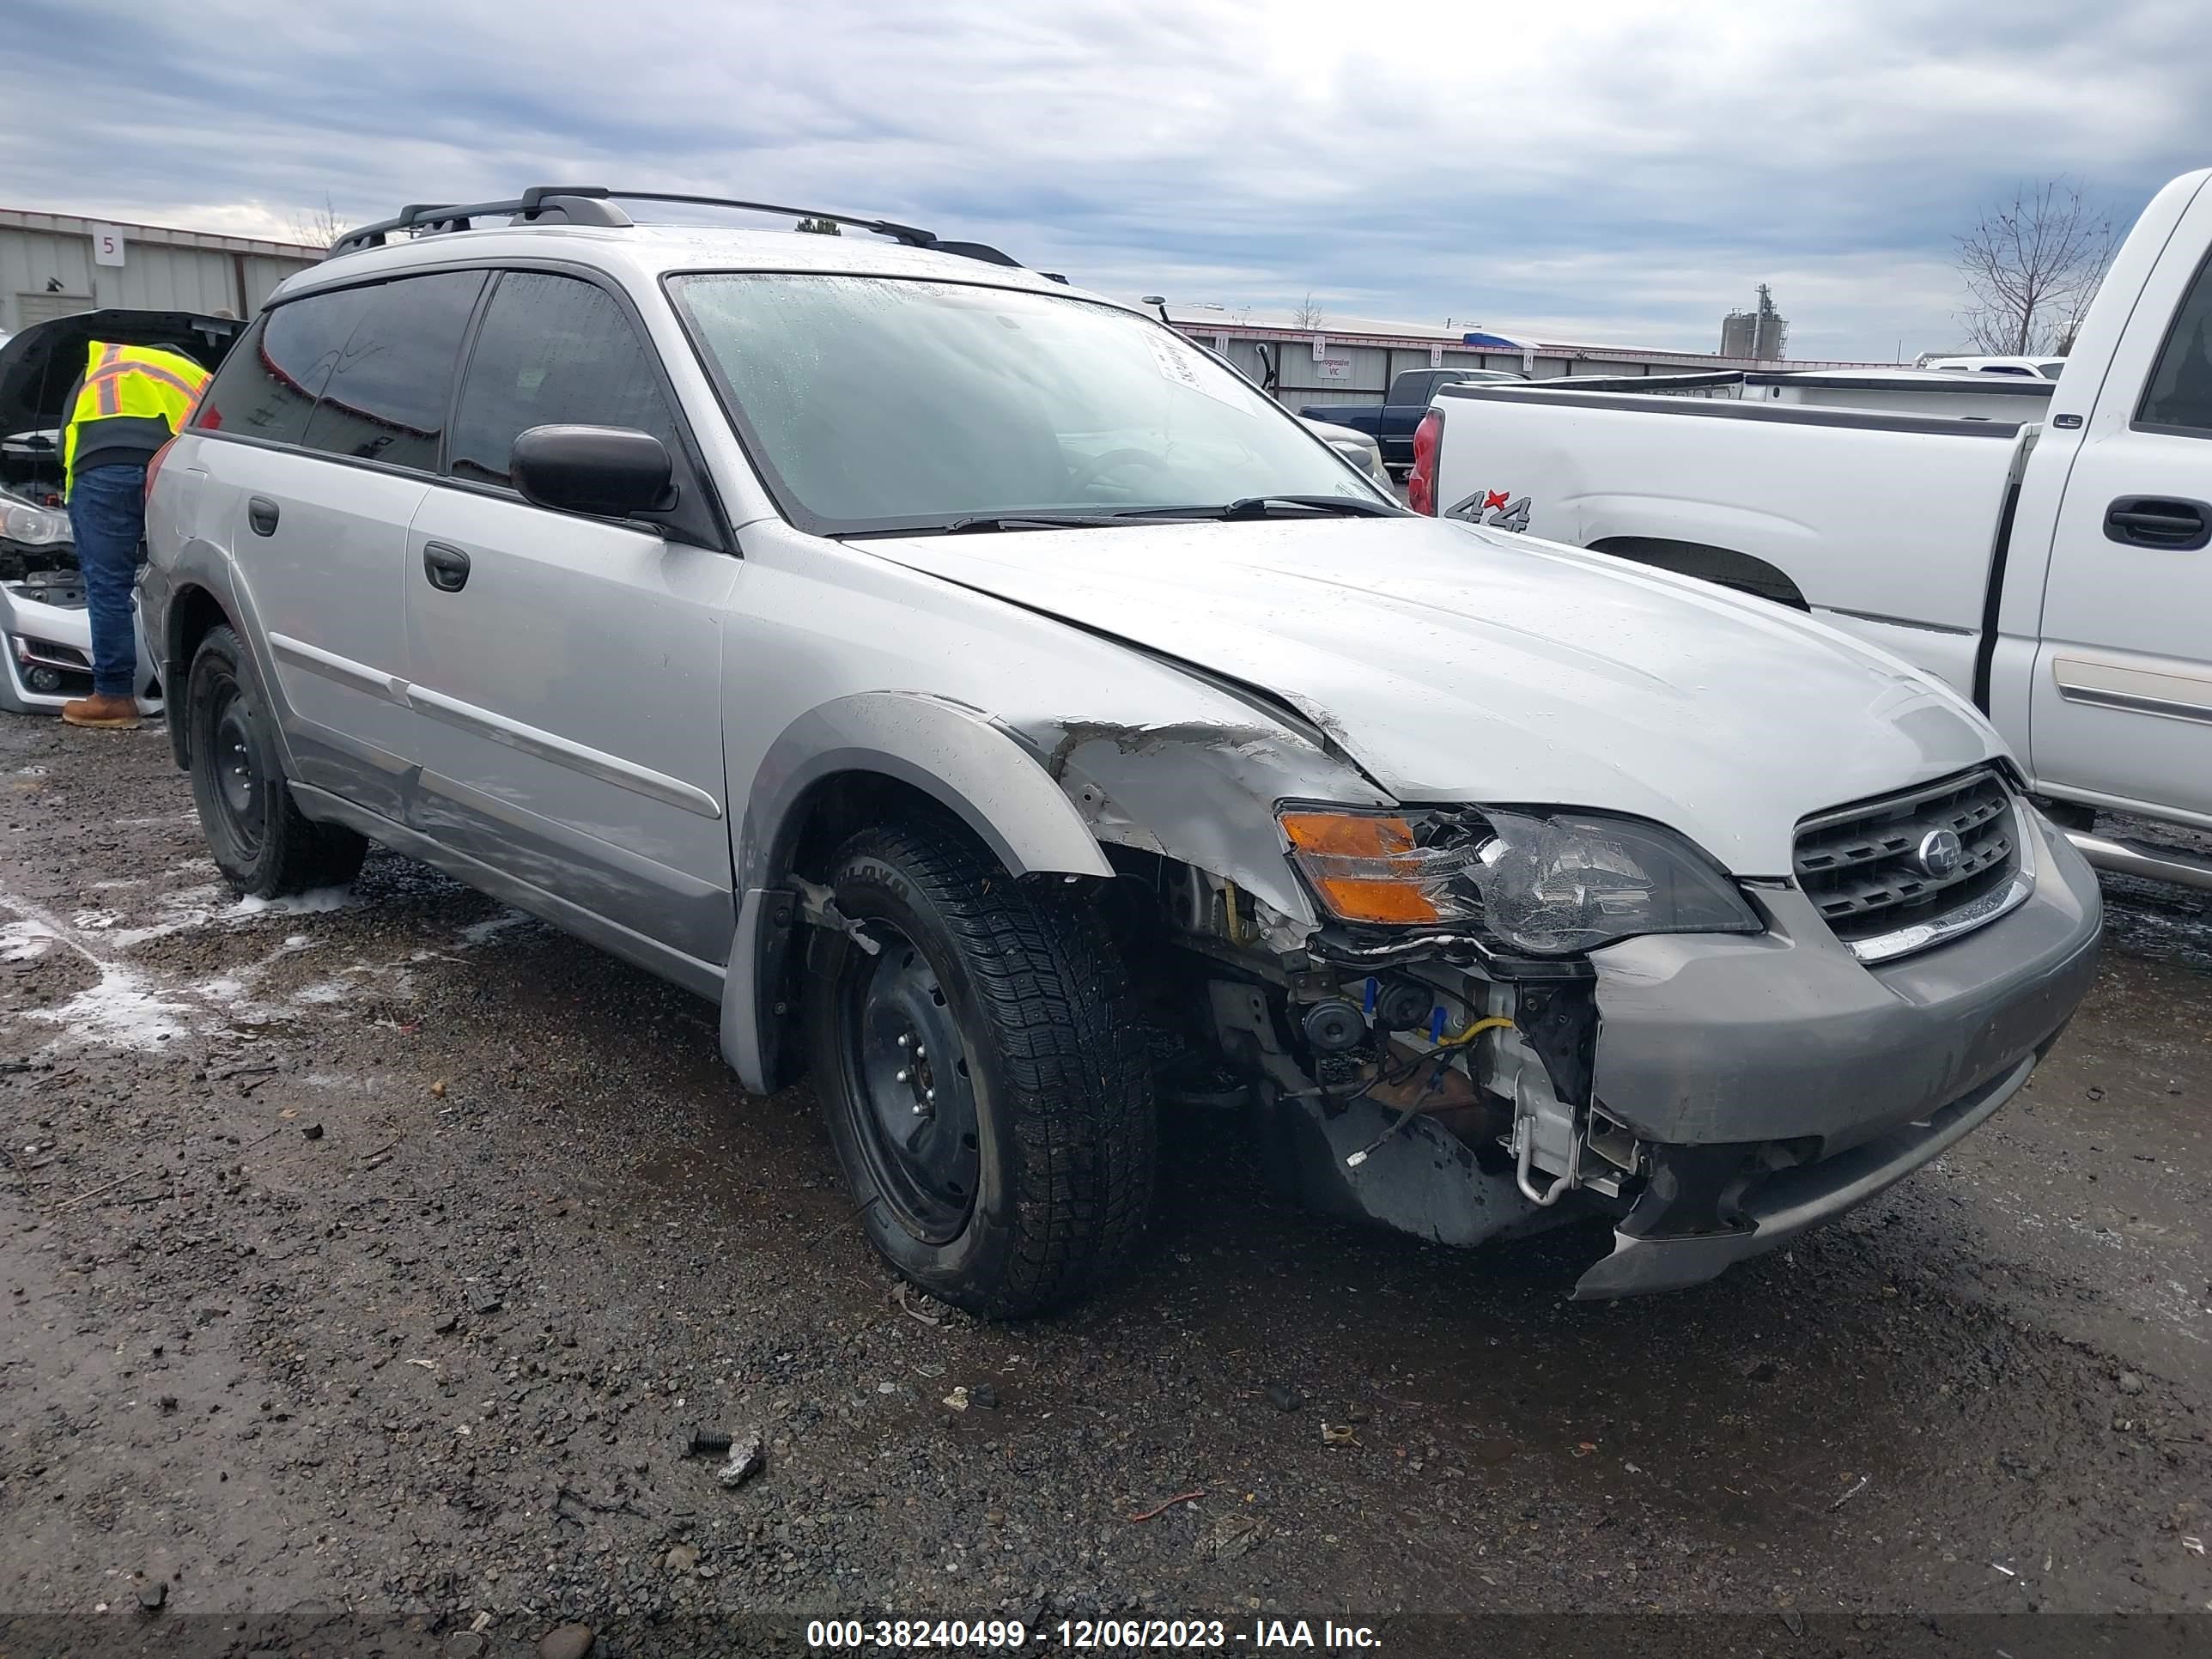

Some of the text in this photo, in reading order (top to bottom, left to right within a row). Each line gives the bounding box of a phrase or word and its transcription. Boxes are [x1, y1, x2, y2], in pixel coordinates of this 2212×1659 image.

[104, 236, 114, 254] 5
[1218, 337, 1225, 350] 11
[1315, 343, 1323, 355] 12
[1432, 349, 1440, 362] 13
[1524, 355, 1532, 365] 14
[1329, 368, 1340, 376] VIC
[2056, 416, 2081, 427] LS
